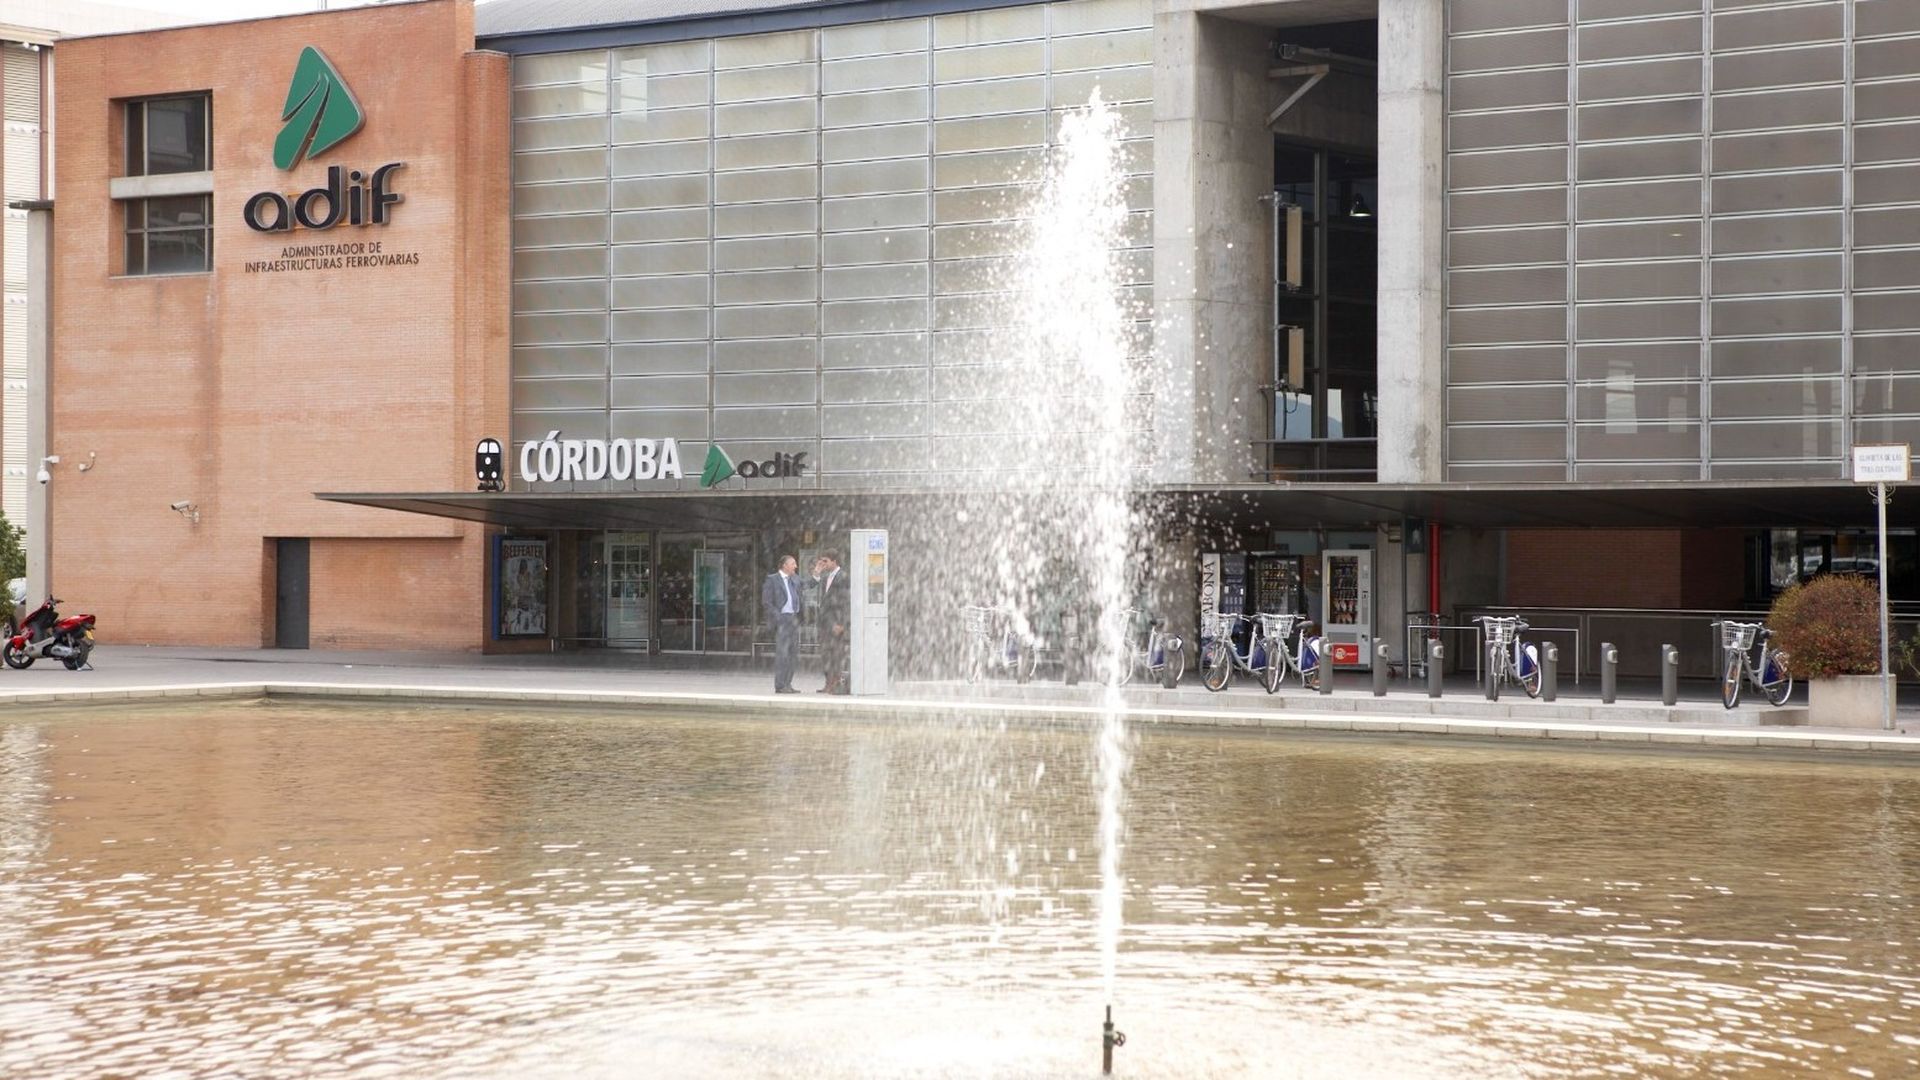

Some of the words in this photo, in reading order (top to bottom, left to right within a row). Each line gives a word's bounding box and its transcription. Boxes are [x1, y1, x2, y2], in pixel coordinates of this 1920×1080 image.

[243, 162, 407, 232] adif
[281, 243, 364, 259] ADMINISTRADOR
[368, 242, 382, 253] DE
[245, 257, 342, 273] INFRAESTRUCTURAS
[346, 253, 420, 268] FERROVIARIAS
[520, 430, 683, 482] CÓRDOBA
[737, 451, 808, 478] adif
[503, 544, 544, 561] BEEFEATER
